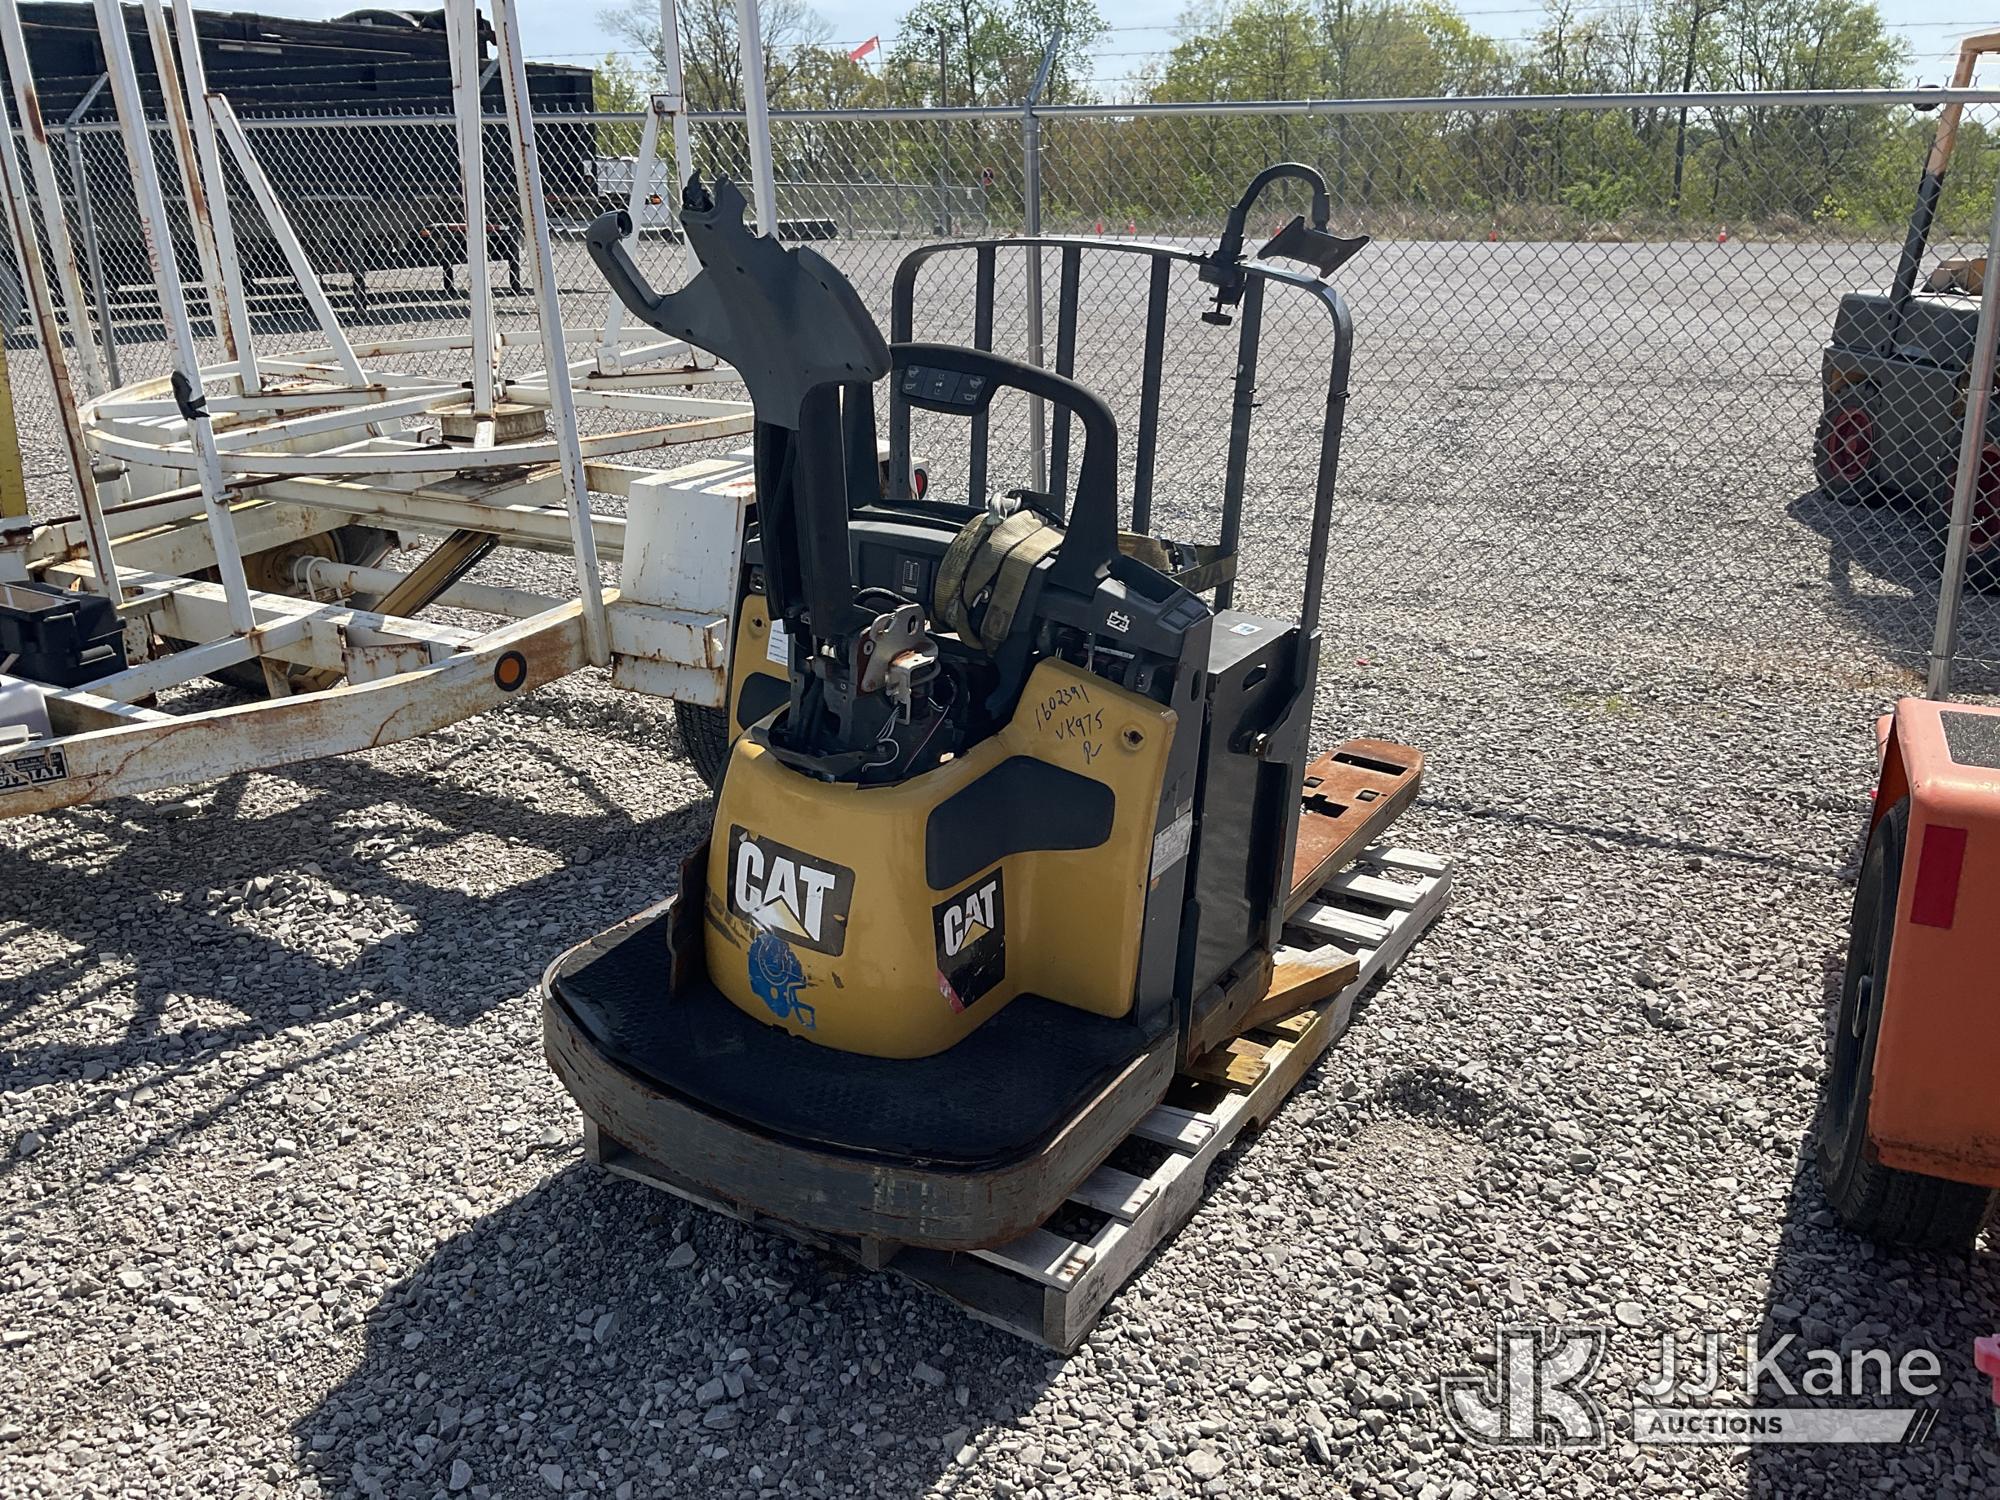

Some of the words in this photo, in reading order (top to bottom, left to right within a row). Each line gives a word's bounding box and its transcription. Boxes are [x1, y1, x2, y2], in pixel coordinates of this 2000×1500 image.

[1034, 683, 1091, 732] 1602391
[735, 841, 836, 942] CAT
[943, 880, 997, 957] CAT
